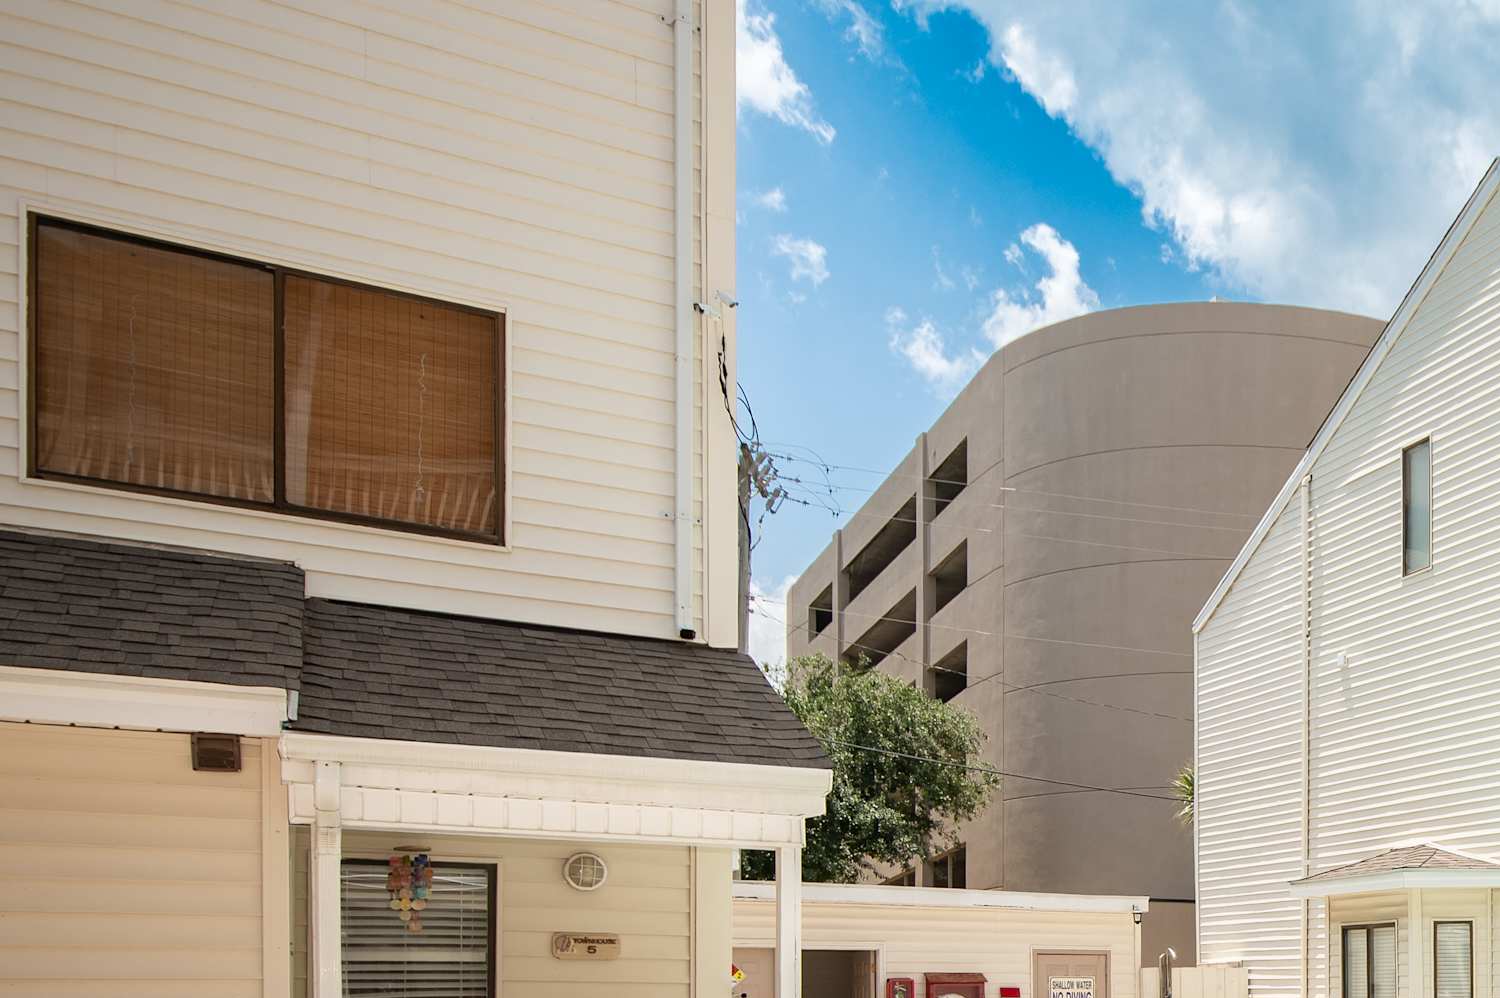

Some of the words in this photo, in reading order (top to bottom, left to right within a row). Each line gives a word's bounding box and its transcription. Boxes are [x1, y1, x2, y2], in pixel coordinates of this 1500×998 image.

[587, 946, 596, 954] 5
[1052, 981, 1074, 989] SHALLOW
[1076, 981, 1092, 989] WATER
